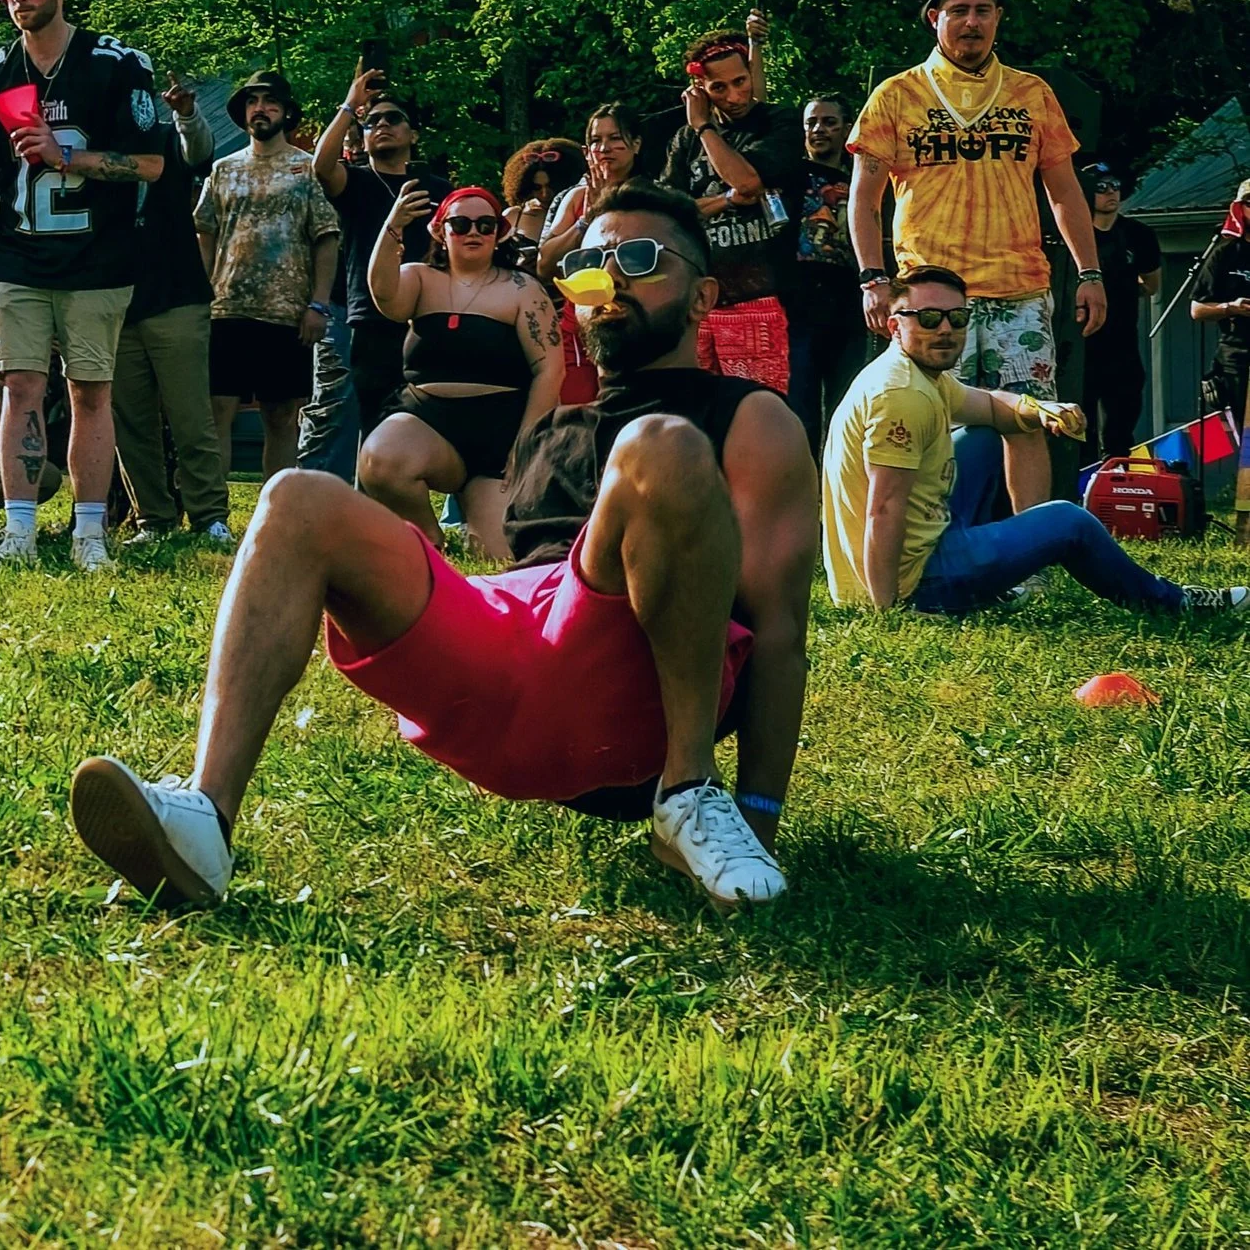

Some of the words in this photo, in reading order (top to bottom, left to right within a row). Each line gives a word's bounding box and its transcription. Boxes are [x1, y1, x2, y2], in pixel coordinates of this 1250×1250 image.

[42, 100, 69, 123] eath
[927, 132, 1032, 161] HOPE
[10, 125, 93, 235] 12
[1112, 487, 1154, 495] HONDA
